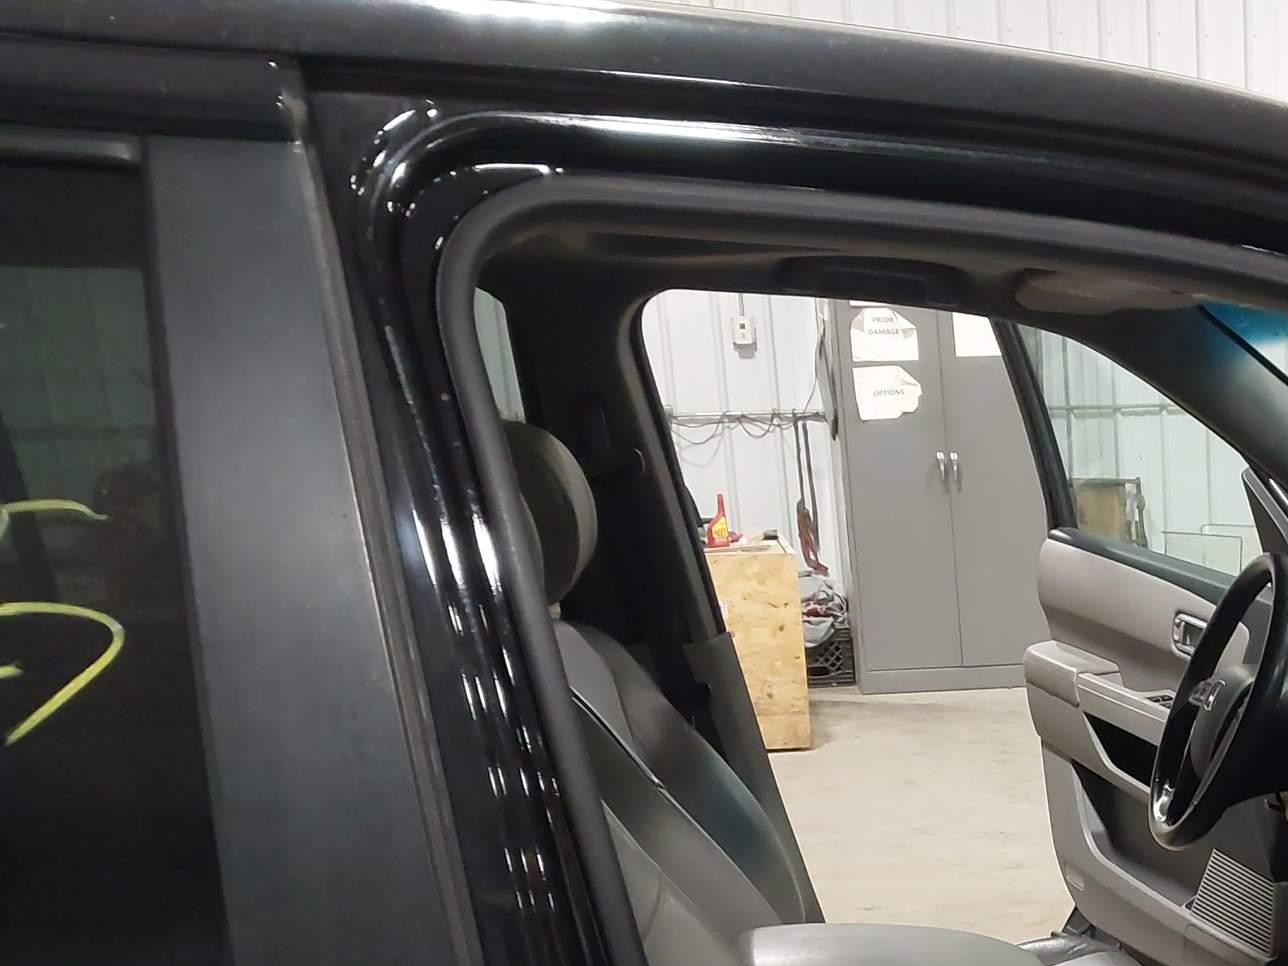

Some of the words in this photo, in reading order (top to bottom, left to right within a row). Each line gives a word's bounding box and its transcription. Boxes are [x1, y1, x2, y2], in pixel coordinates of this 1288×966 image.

[872, 316, 894, 324] PRIOR
[868, 328, 899, 336] DAMAGE
[873, 388, 905, 397] OPTIONS
